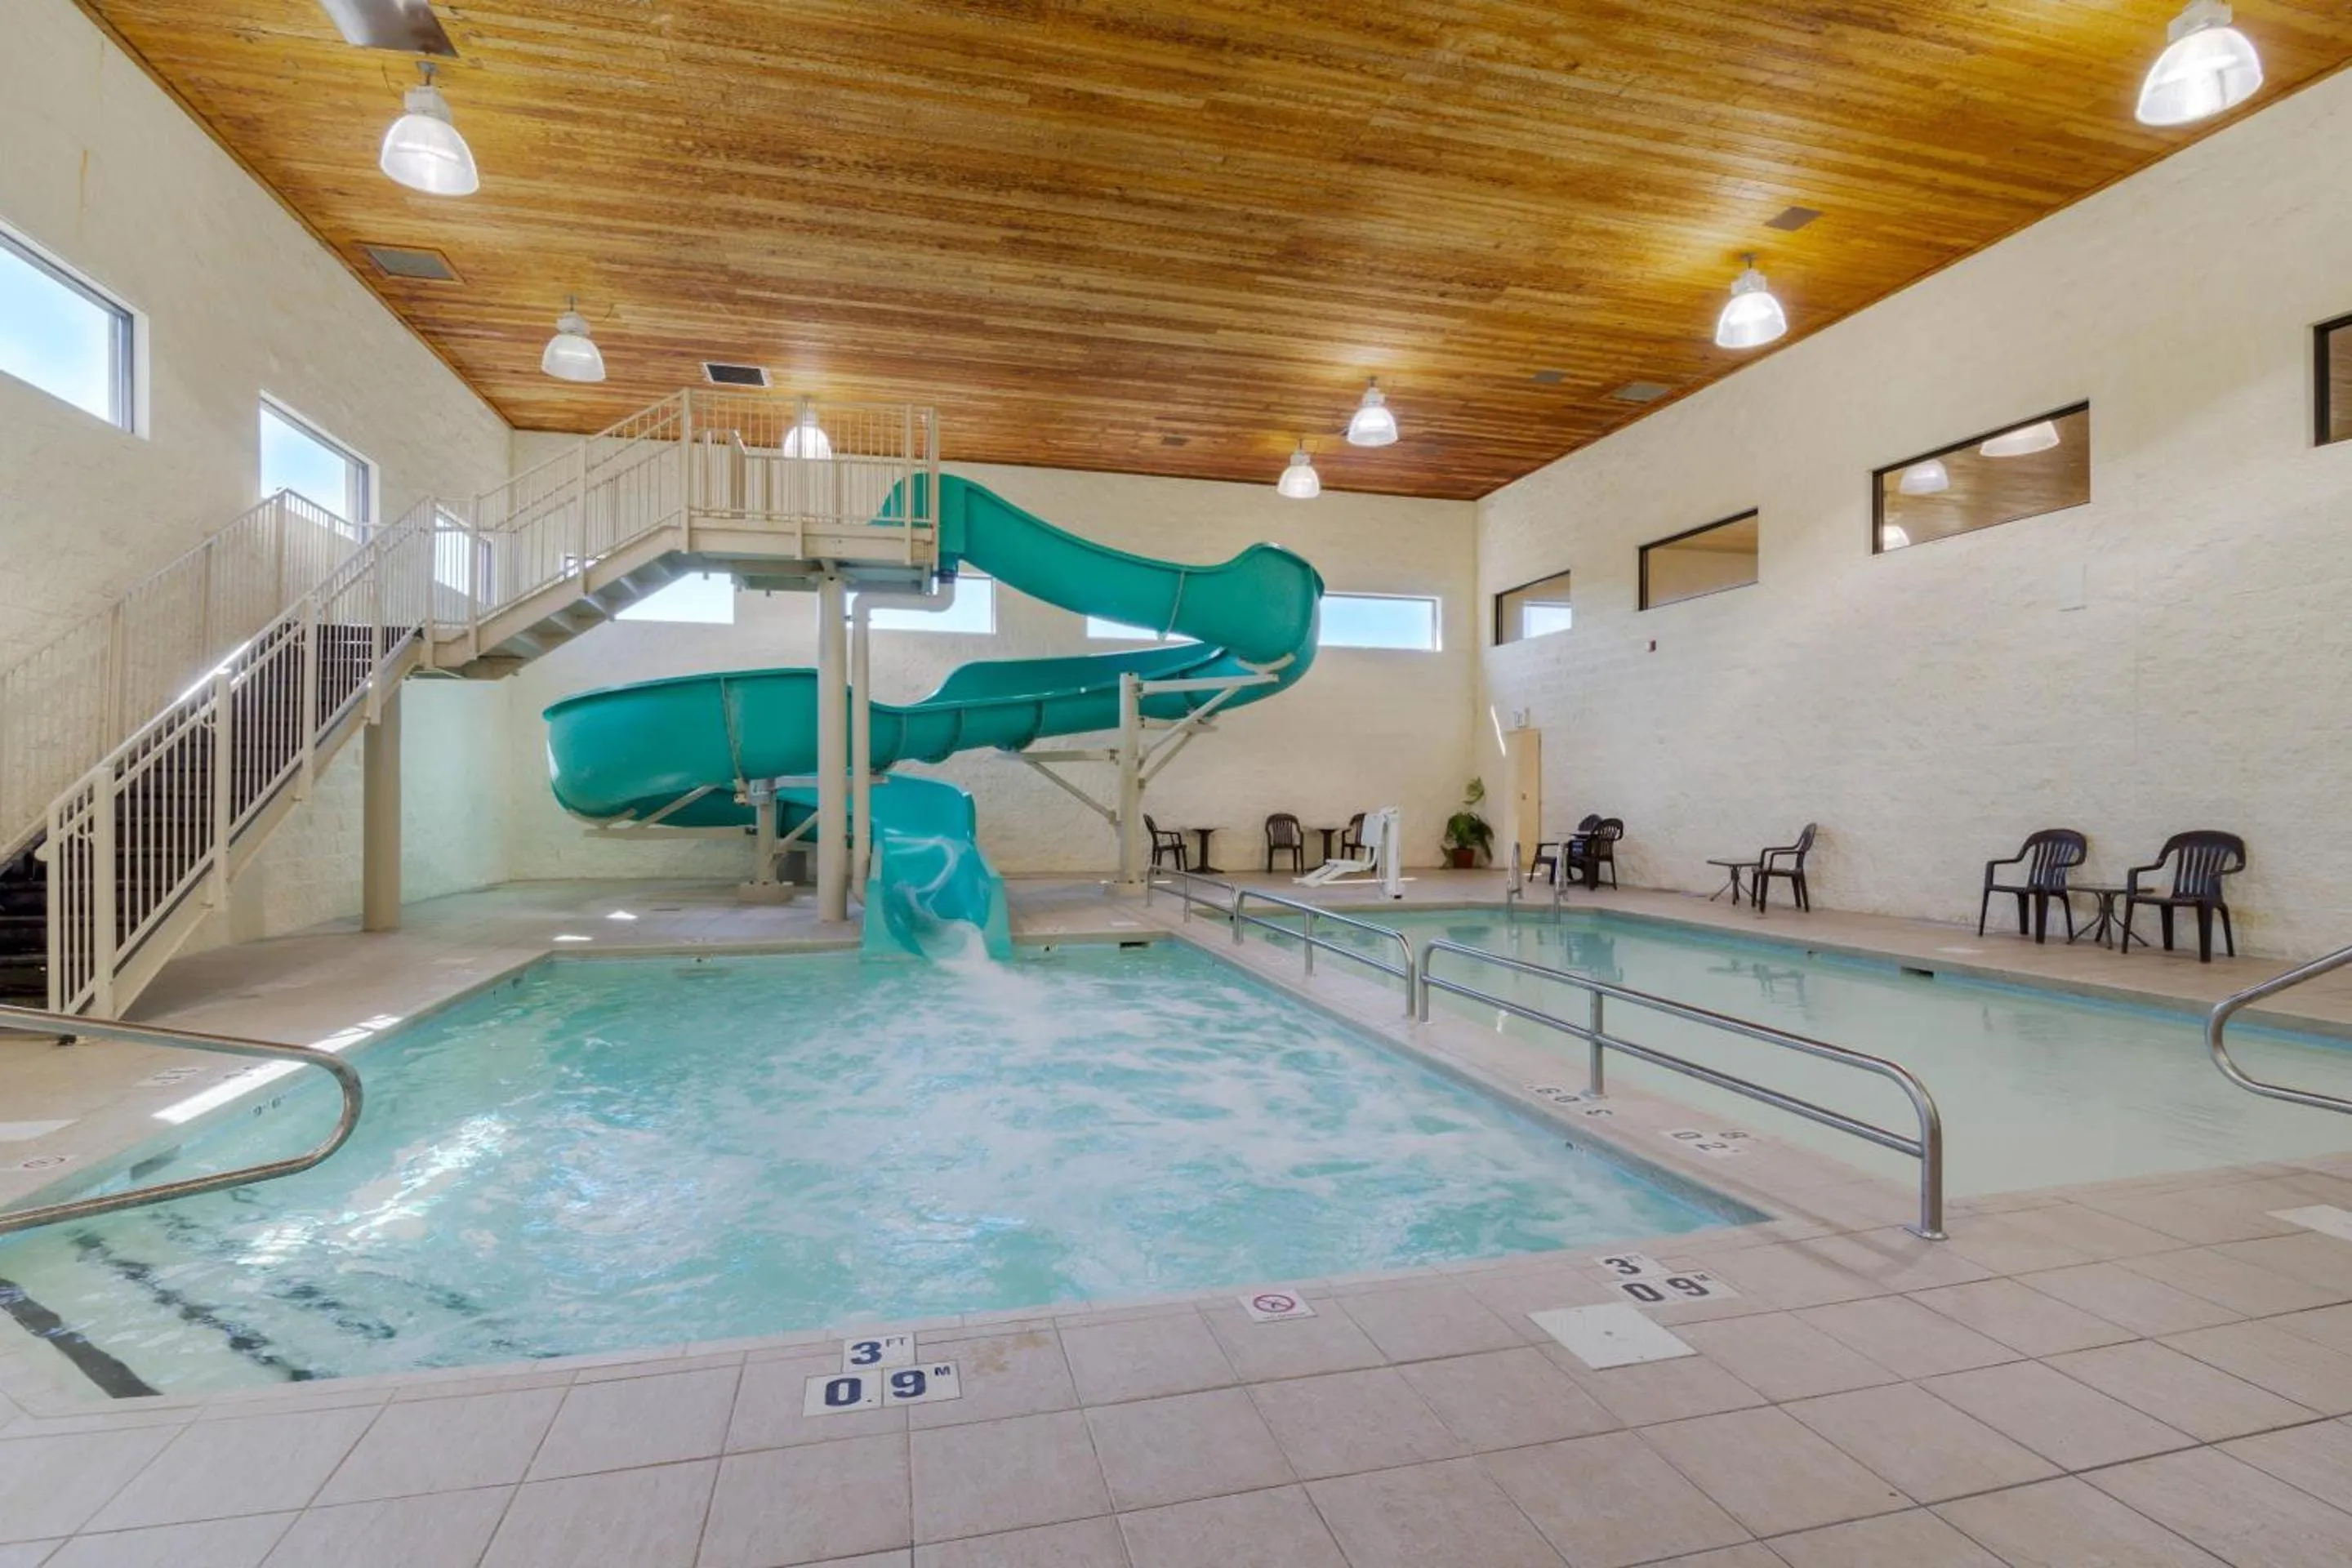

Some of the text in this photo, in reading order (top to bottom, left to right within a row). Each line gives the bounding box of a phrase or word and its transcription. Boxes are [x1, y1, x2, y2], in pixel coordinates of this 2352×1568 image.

[1605, 1258, 1642, 1275] 3
[850, 1337, 907, 1365] 3 FT
[934, 1365, 951, 1376] M
